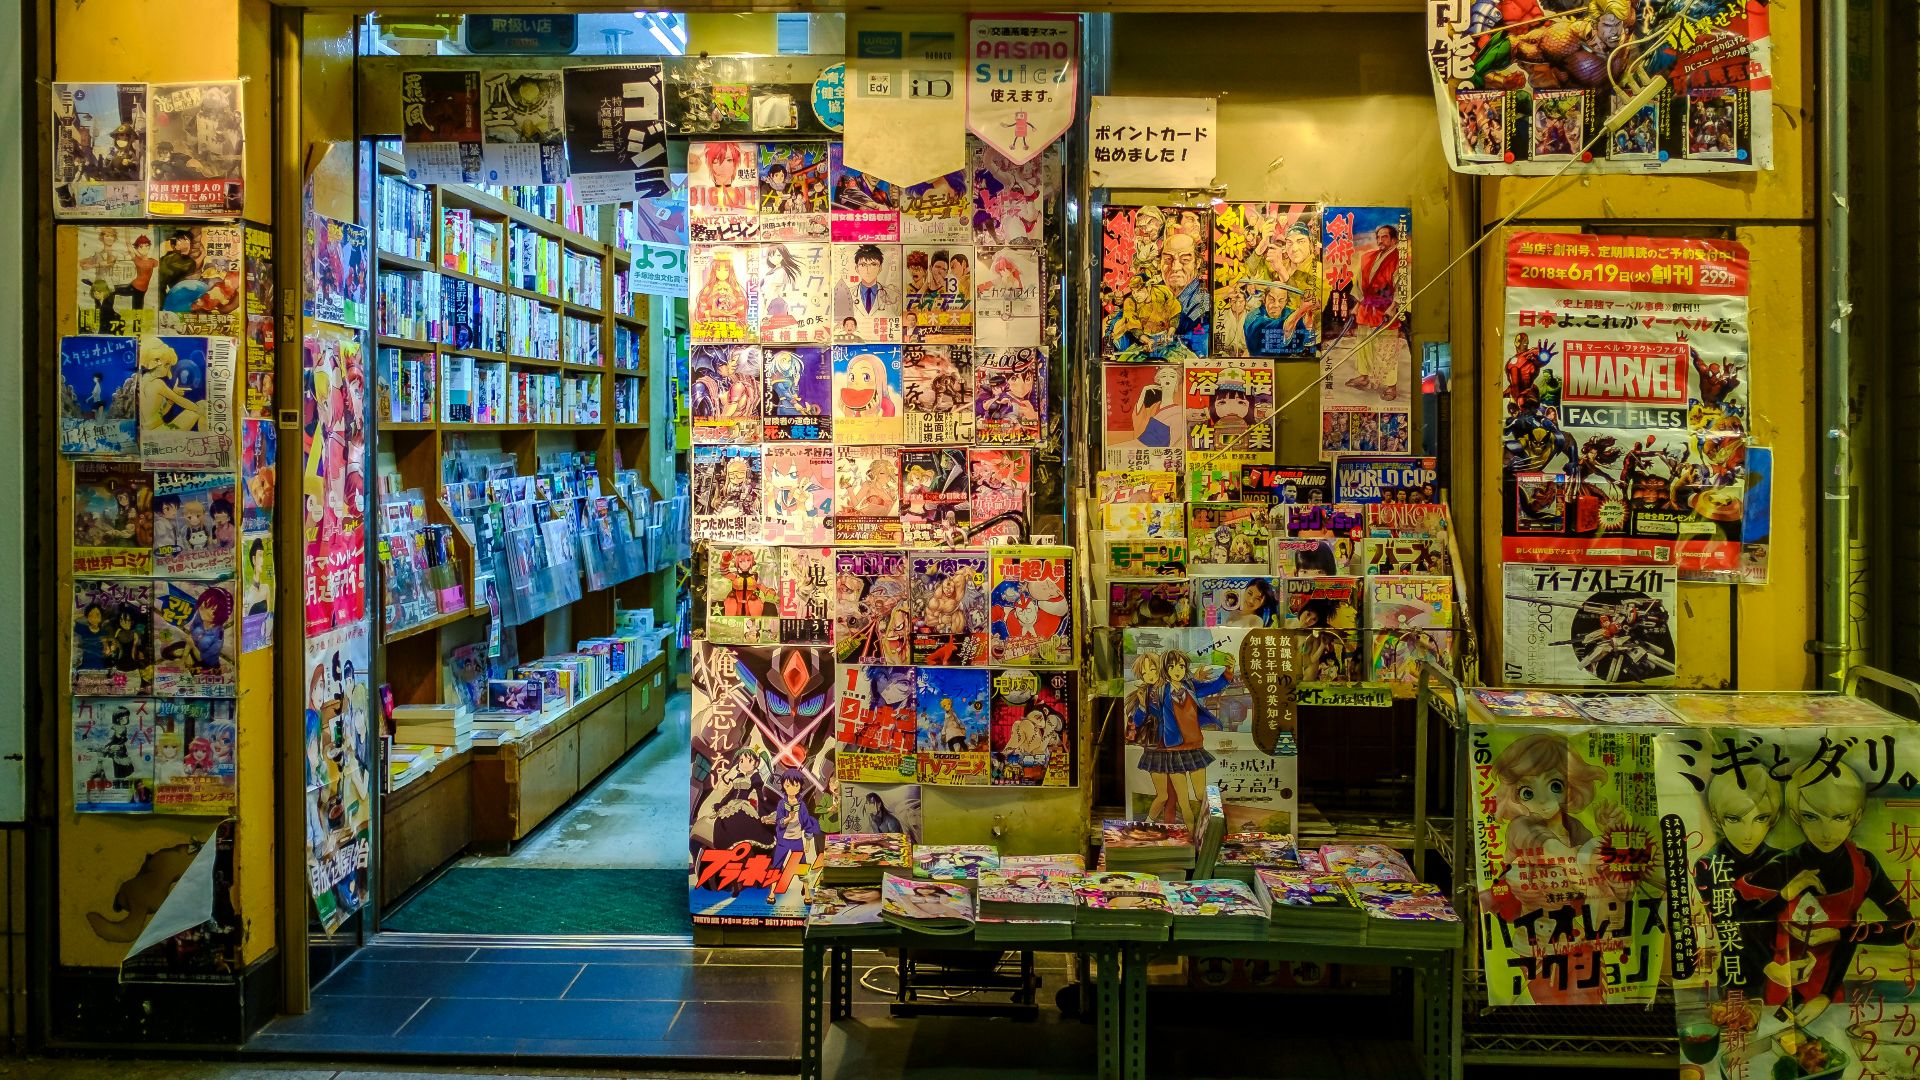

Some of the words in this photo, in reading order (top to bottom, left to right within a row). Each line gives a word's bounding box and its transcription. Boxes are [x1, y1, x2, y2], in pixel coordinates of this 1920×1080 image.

[492, 18, 551, 33] 取扱い店
[991, 26, 1068, 37] 交通系電子マネー
[976, 40, 1068, 59] PASMO
[976, 63, 1067, 84] Suica
[870, 83, 888, 93] Edy
[911, 79, 952, 98] iD
[990, 88, 1053, 103] 使えます。
[1095, 126, 1208, 143] ポイントカード
[1095, 146, 1189, 163] 始めました!
[206, 242, 233, 250] 異世界
[1214, 204, 1248, 287] 剣術抄
[1325, 211, 1355, 292] 剣術抄
[230, 262, 239, 271] 2
[1520, 262, 1694, 286] 2018年6月19日(火)創刊
[943, 277, 958, 293] 13
[1699, 269, 1736, 285] 299円
[455, 279, 467, 325] 星野之宣
[1518, 309, 1738, 335] 日本よ、これがマーベルだ。
[762, 330, 825, 342] 縦横無尽
[833, 346, 901, 362] 銀のニーナ
[1188, 370, 1273, 397] 溶接
[1569, 355, 1682, 399] MARVEL
[763, 417, 818, 426] 冒険者の運命は
[922, 412, 933, 443] の出現
[934, 412, 944, 443] 仮面兵
[1569, 408, 1617, 426] FACT
[1628, 409, 1681, 428] FILES
[1190, 424, 1273, 450] 作業
[1301, 474, 1326, 486] KING
[1339, 469, 1399, 488] WORLD
[1402, 469, 1437, 488] CUP
[1339, 486, 1382, 498] RUSSIA
[819, 497, 832, 514] 4
[1369, 539, 1434, 565] バーズ
[73, 552, 150, 573] 異世界コミケ
[913, 558, 985, 578] キン肉マン
[973, 574, 983, 583] 63
[1202, 579, 1249, 591] ヤングジャンプ
[1288, 580, 1312, 593] DVD
[1530, 566, 1676, 593] ディープ・ストライカー
[1423, 593, 1450, 601] MOMO
[1249, 635, 1263, 685] 知る旅へ。
[992, 676, 1038, 699] 鬼滅の刃
[1053, 677, 1062, 687] 11
[1264, 636, 1279, 730] 数百年前の英知を
[707, 647, 739, 792] 俺は忘れない
[1676, 735, 1897, 793] ミギとダリ
[1213, 777, 1283, 794] 女子高生
[694, 841, 824, 895] プラネット
[1674, 818, 1695, 963] スタイリッシュな高校生の次は、
[1708, 853, 1748, 987] 佐野菜見
